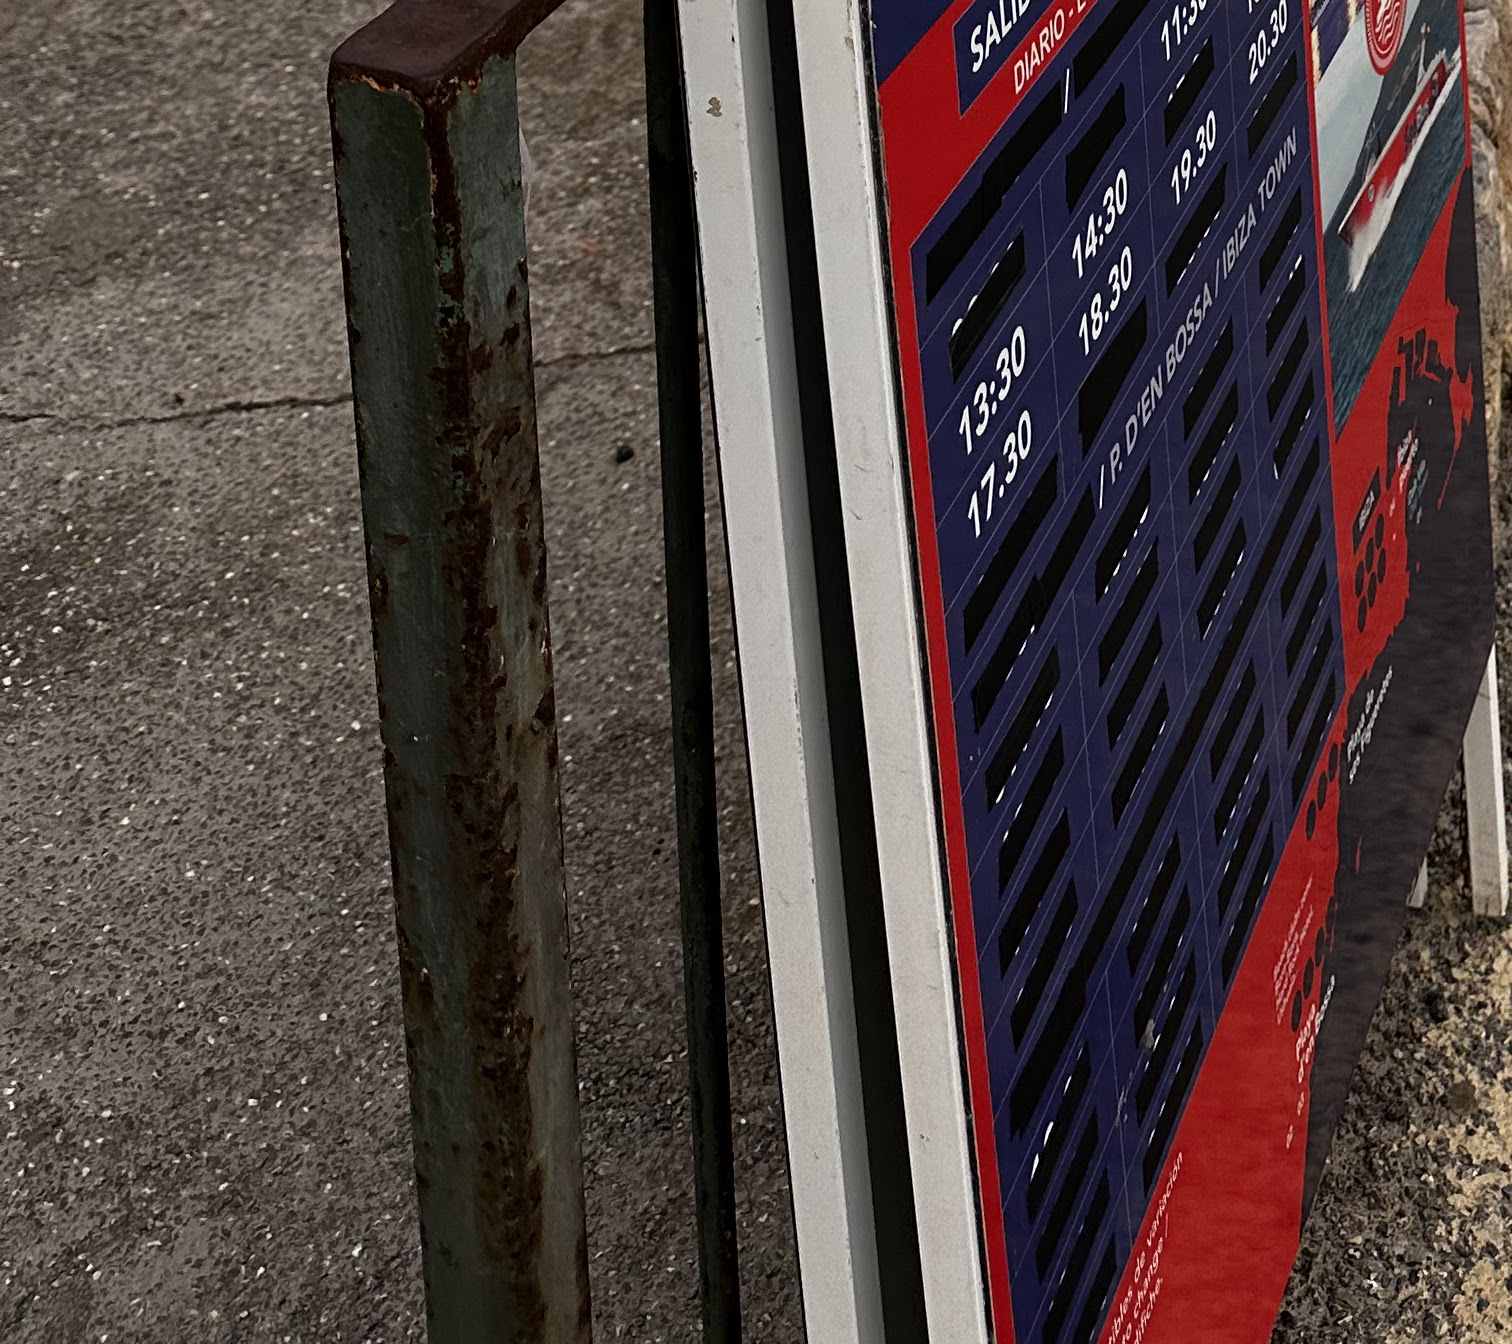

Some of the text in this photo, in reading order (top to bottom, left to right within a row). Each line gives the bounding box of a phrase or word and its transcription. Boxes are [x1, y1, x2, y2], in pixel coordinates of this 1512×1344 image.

[1013, 8, 1066, 95] DIARIO
[959, 325, 1026, 456] 13:30
[1071, 168, 1128, 279] 14:30
[968, 410, 1032, 539] 17.30
[1078, 245, 1132, 356] 18.30
[1170, 109, 1217, 205] 19.30
[1109, 442, 1123, 485] P.
[1125, 363, 1163, 457] D'EN
[1165, 291, 1213, 384] BOSSA
[1222, 201, 1257, 281] IBIZA
[1258, 125, 1296, 212] TOWN
[1134, 1250, 1146, 1284] de
[1134, 1236, 1164, 1319] change
